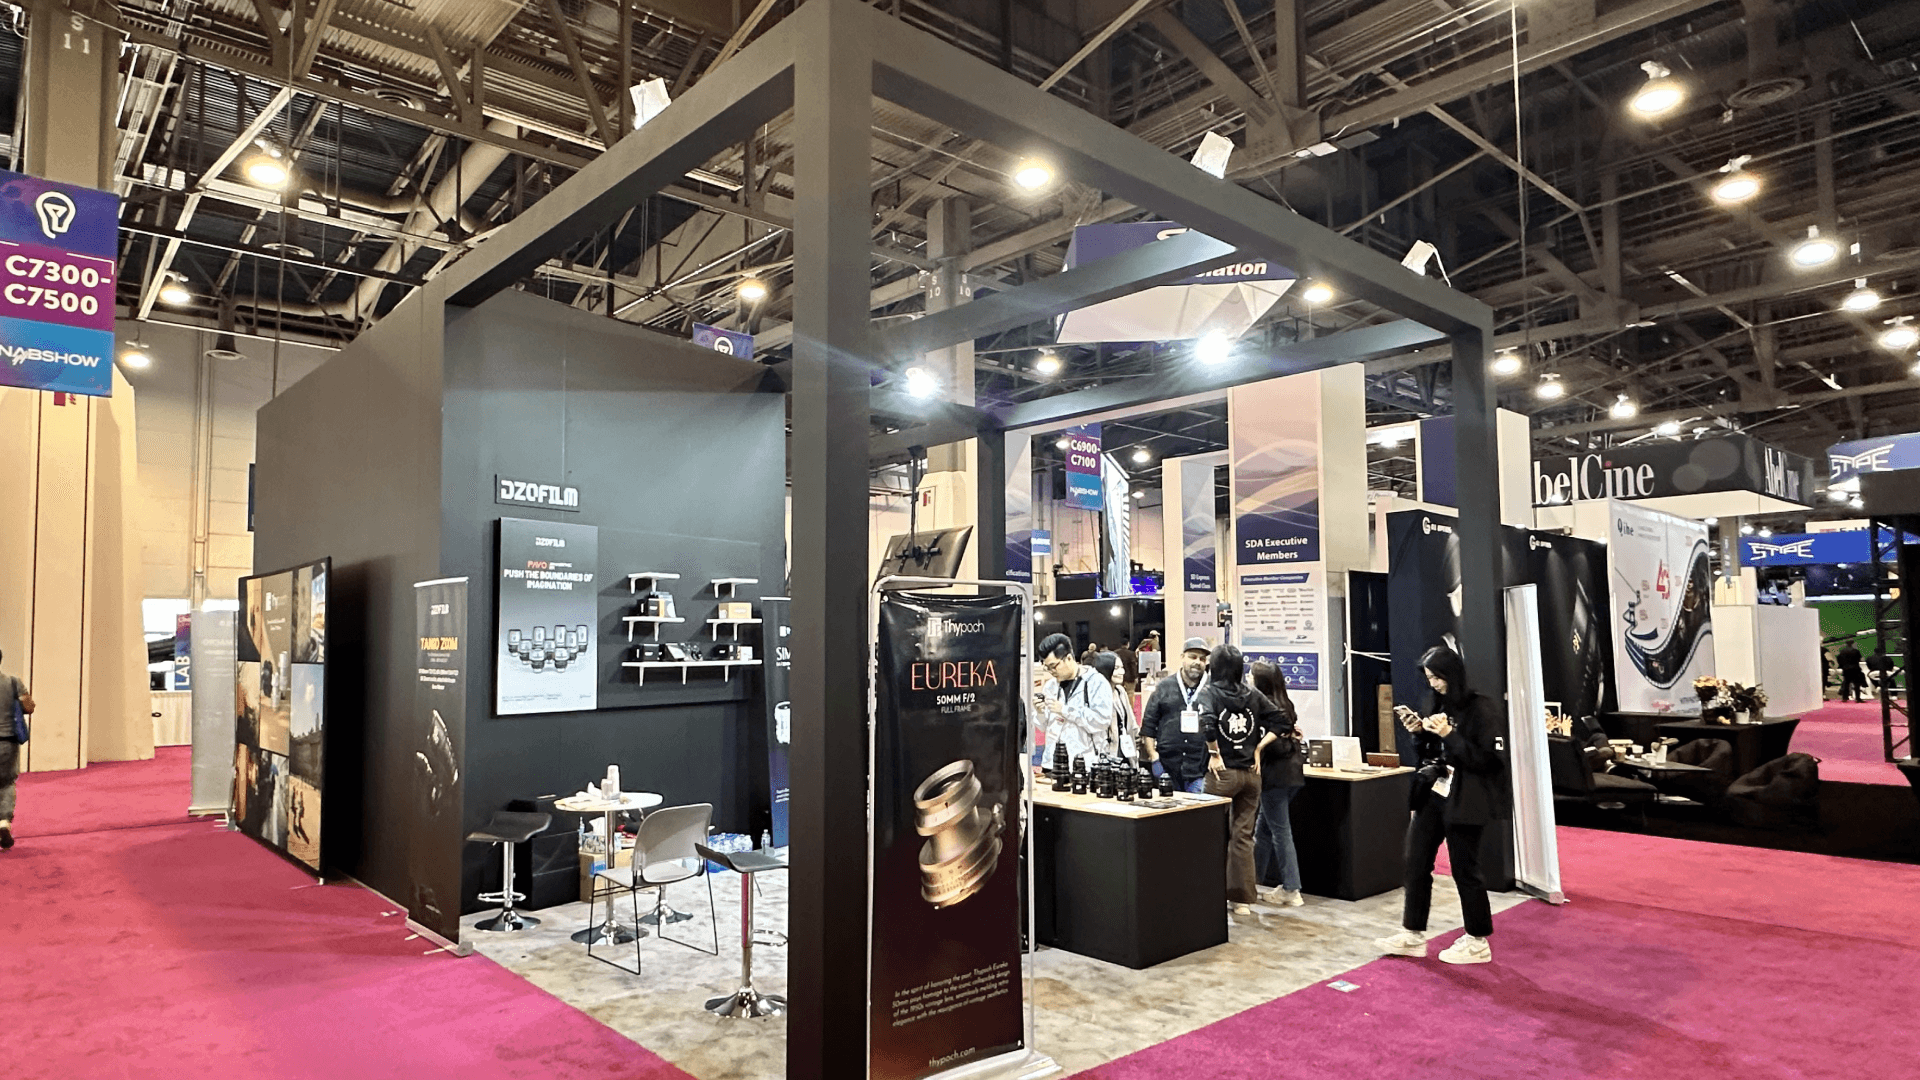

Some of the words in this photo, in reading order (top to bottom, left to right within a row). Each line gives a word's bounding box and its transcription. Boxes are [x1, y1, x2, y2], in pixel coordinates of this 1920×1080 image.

[5, 255, 111, 287] C7300-
[1195, 262, 1267, 277] ation
[4, 283, 98, 315] C7500
[0, 344, 100, 367] NABSHOW
[1071, 440, 1100, 454] C6900-
[1071, 454, 1096, 468] C7100
[501, 480, 578, 506] DZOFILM
[1245, 539, 1263, 548] SDA
[1265, 536, 1308, 547] Executive
[1257, 551, 1298, 560] Members
[504, 569, 524, 578] PUSH
[525, 570, 539, 579] THE
[540, 571, 583, 582] BOUNDARIES
[584, 573, 593, 582] OF
[526, 580, 572, 590] IMAGINATION
[943, 619, 985, 636] Thypoch
[175, 655, 190, 685] LAB
[911, 660, 997, 690] EUREKA
[937, 695, 961, 705] 50MM
[962, 693, 976, 703] F/2
[941, 706, 954, 714] FULL
[924, 981, 930, 990] of
[993, 961, 1008, 970] Eureka
[893, 1008, 900, 1018] of
[929, 1047, 976, 1068] thypoch.com
